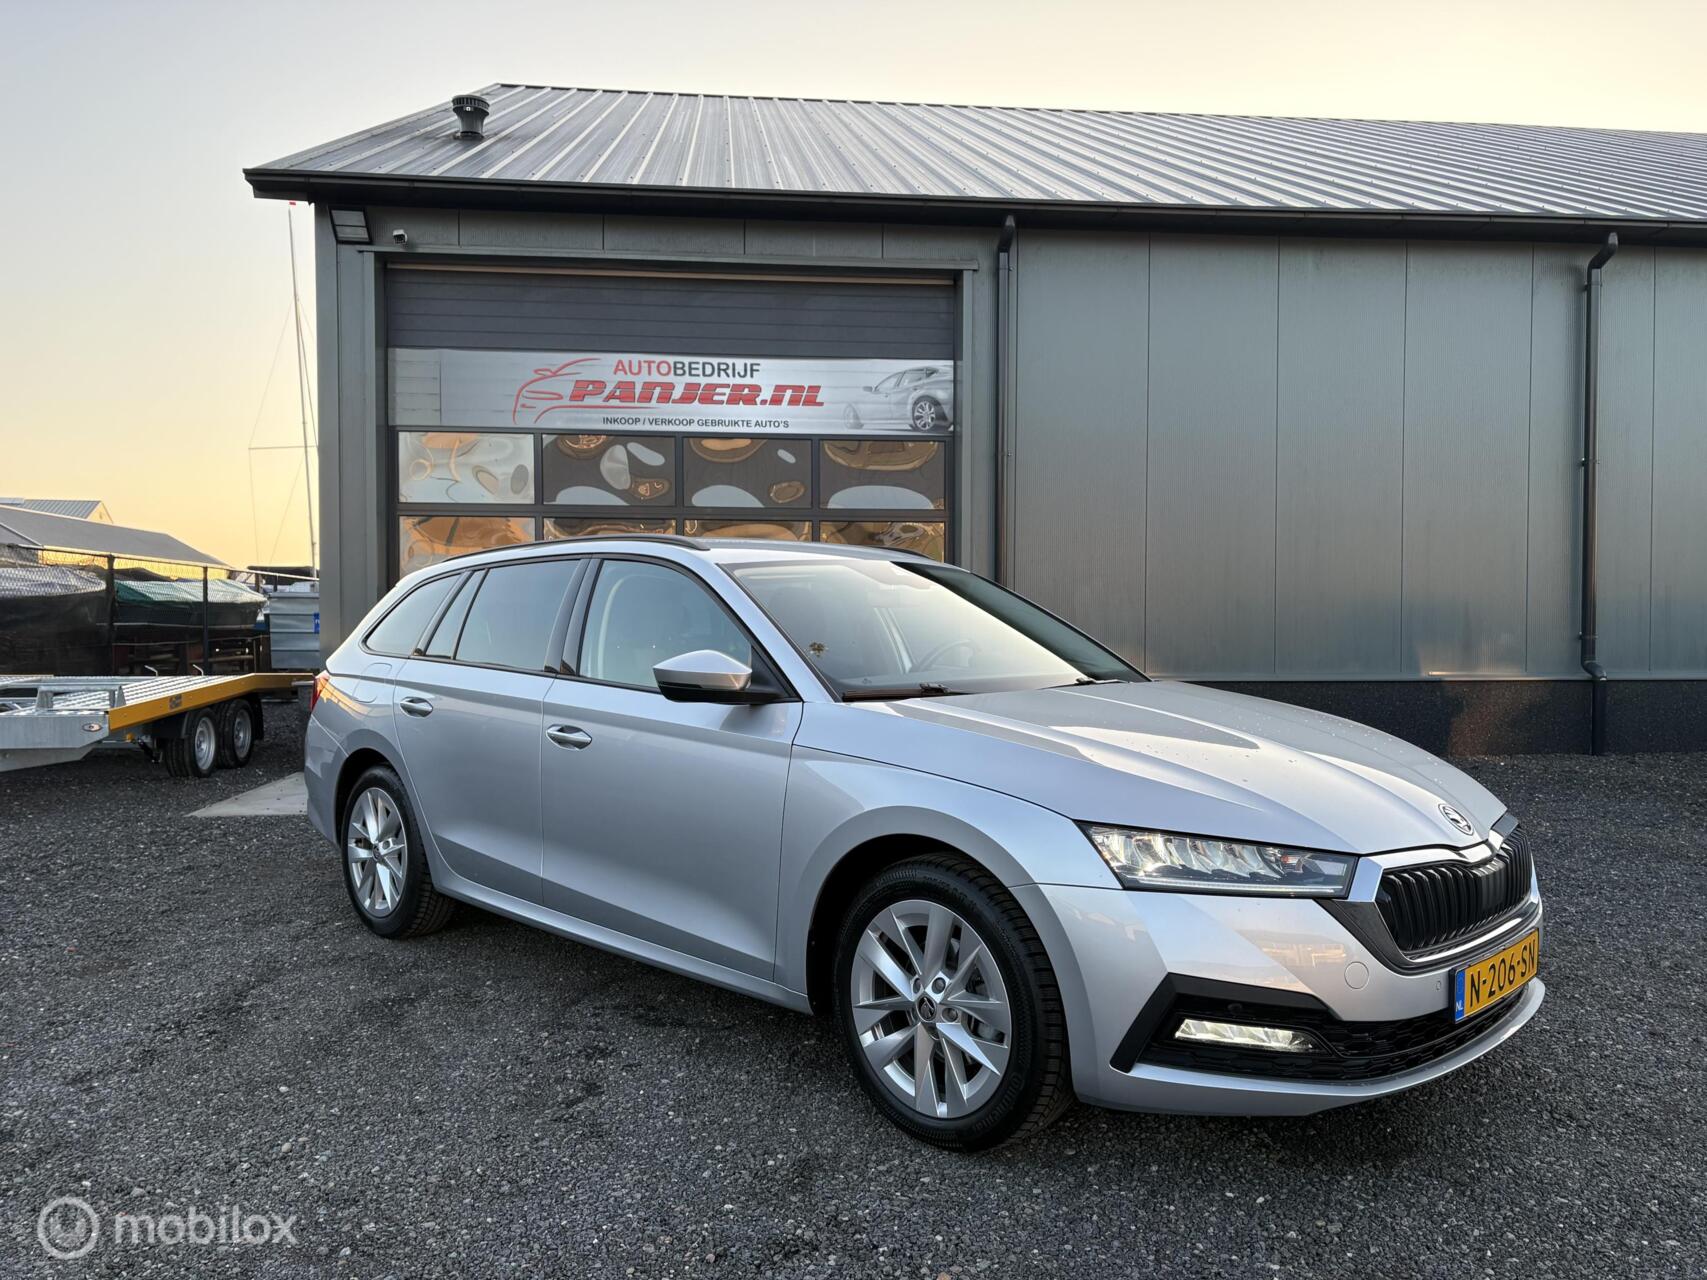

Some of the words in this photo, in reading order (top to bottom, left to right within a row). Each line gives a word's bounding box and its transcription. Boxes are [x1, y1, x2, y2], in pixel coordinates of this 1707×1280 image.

[613, 359, 761, 378] AUTOBEDRIJF
[602, 416, 641, 425] INKOOP
[649, 417, 695, 427] VERKOOP
[697, 419, 752, 428] GEBRUIKTE
[754, 420, 789, 429] AUTO'S
[1470, 939, 1535, 1008] N-206-SN
[1456, 999, 1464, 1012] NL
